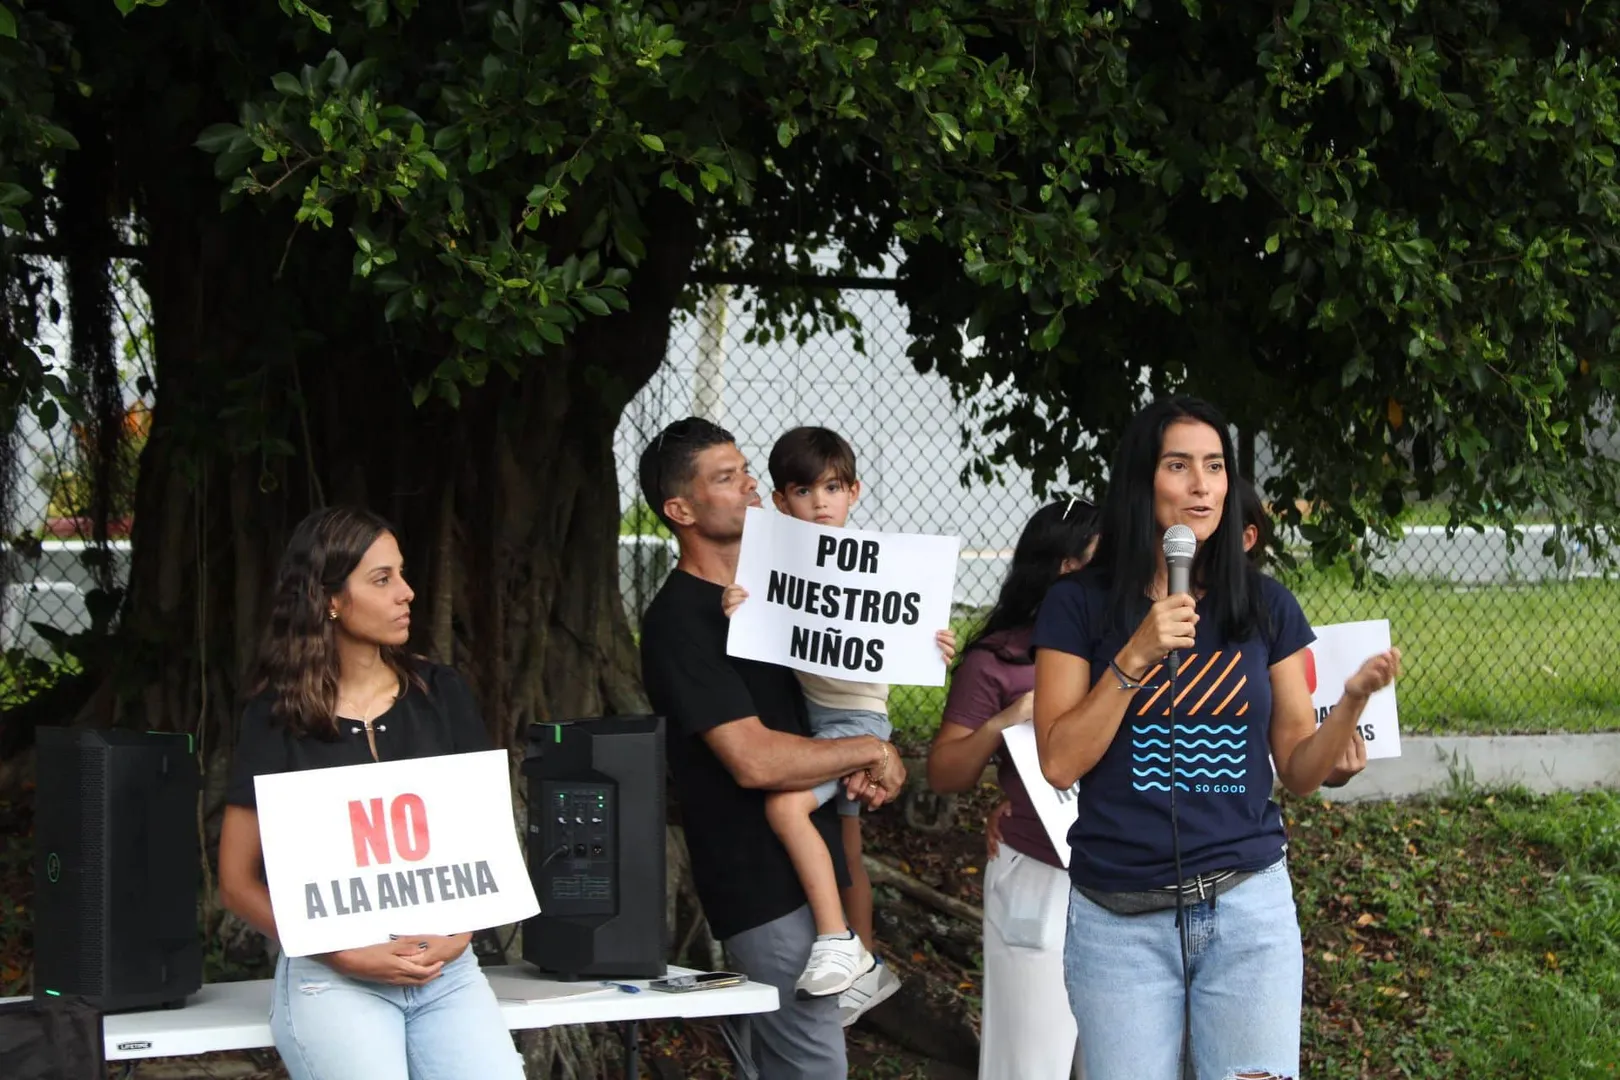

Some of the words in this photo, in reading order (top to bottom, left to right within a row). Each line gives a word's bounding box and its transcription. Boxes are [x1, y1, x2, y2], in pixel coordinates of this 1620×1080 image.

[816, 534, 880, 574] POR
[766, 569, 921, 626] NUESTROS
[790, 625, 885, 673] NIÑOS
[1195, 784, 1210, 793] SO
[1213, 784, 1246, 793] GOOD
[347, 793, 431, 868] NO
[304, 882, 328, 920] A
[330, 877, 373, 916] LA
[376, 860, 499, 910] ANTENA
